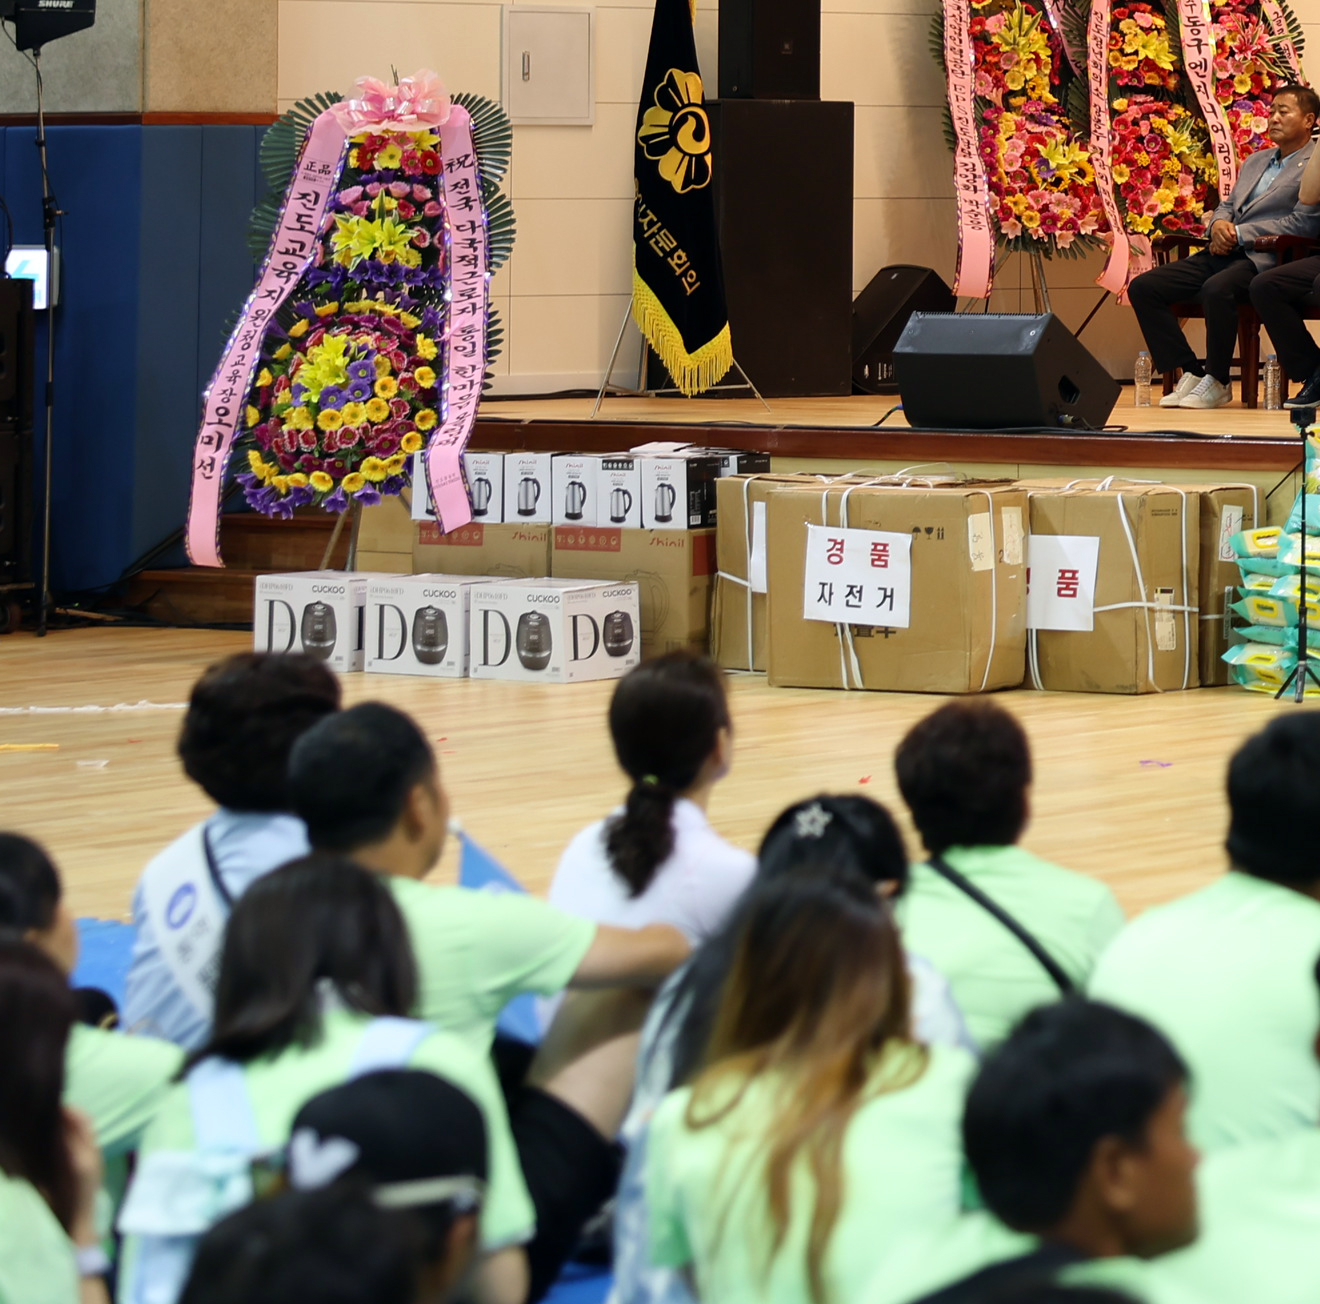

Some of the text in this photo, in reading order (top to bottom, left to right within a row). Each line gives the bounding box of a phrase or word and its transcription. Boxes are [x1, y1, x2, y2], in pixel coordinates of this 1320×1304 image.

[303, 160, 331, 176] 正品
[449, 178, 478, 212] 전국
[312, 585, 345, 594] CUCKOO
[423, 589, 457, 599] CUCKOO
[602, 588, 632, 599] CUCKOO
[526, 594, 560, 604] CUCKOO
